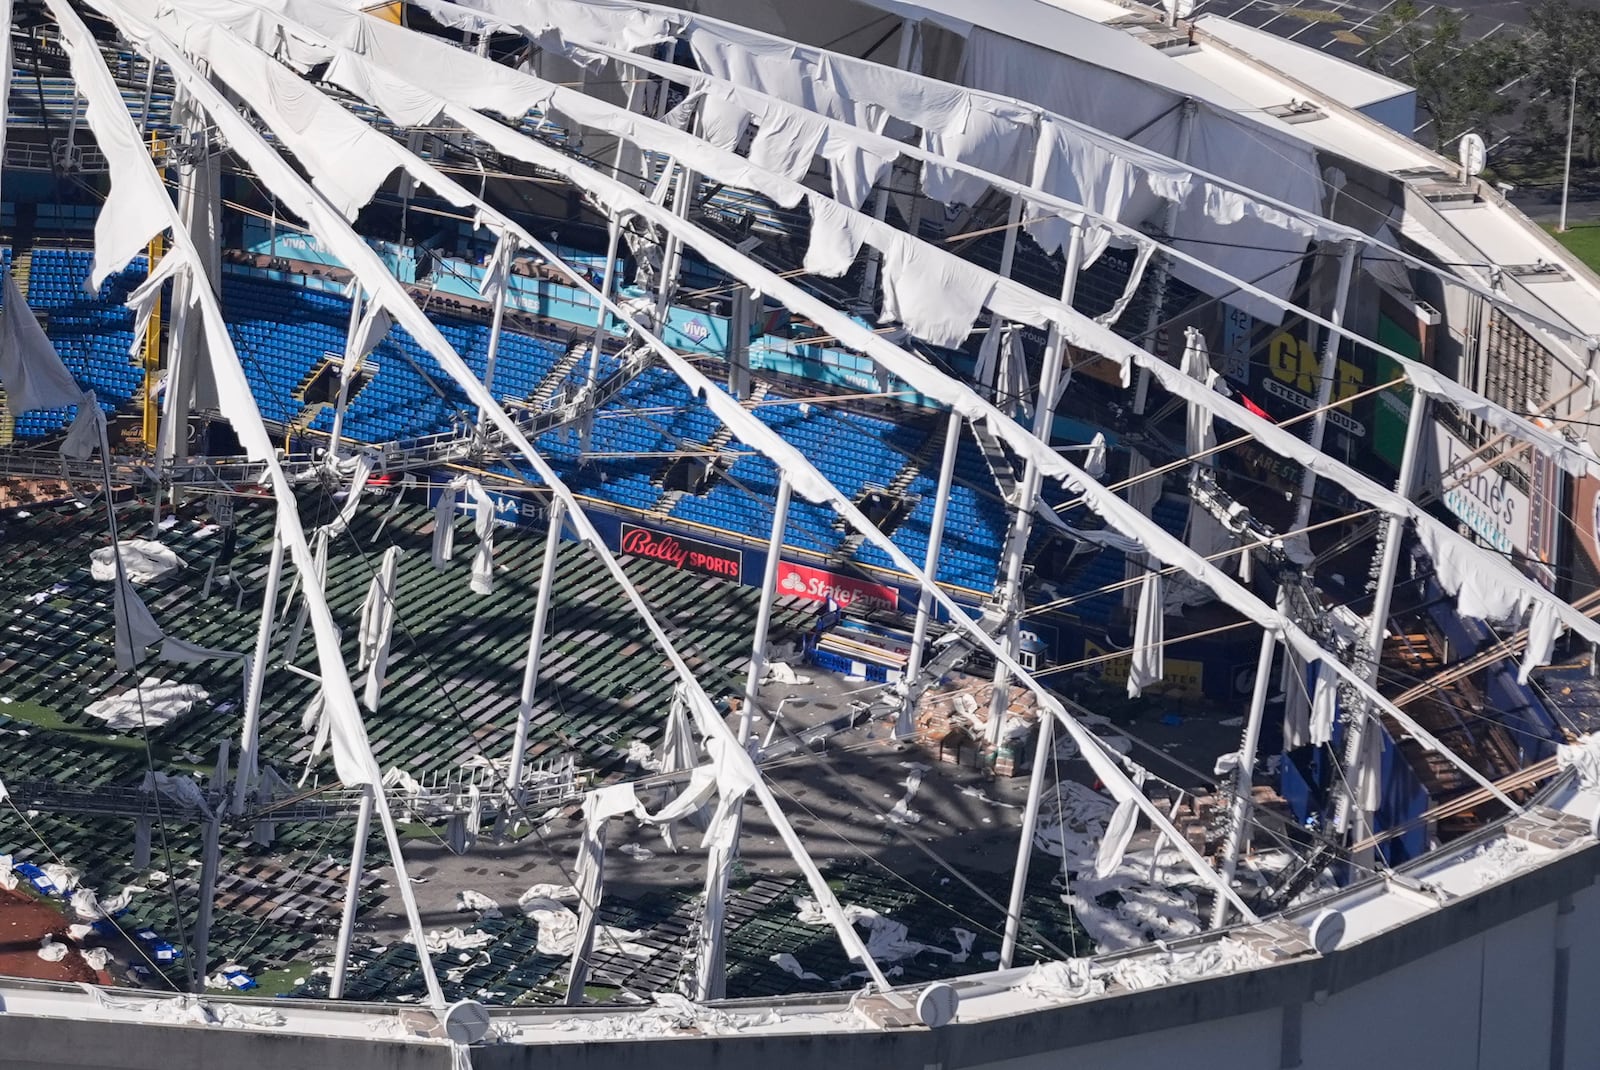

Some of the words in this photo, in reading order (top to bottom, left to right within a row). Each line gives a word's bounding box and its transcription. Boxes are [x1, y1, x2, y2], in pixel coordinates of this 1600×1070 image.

[282, 237, 306, 250] VIVA
[1270, 382, 1312, 409] STEEL
[622, 529, 688, 570] Bally
[690, 551, 738, 577] SPORTS
